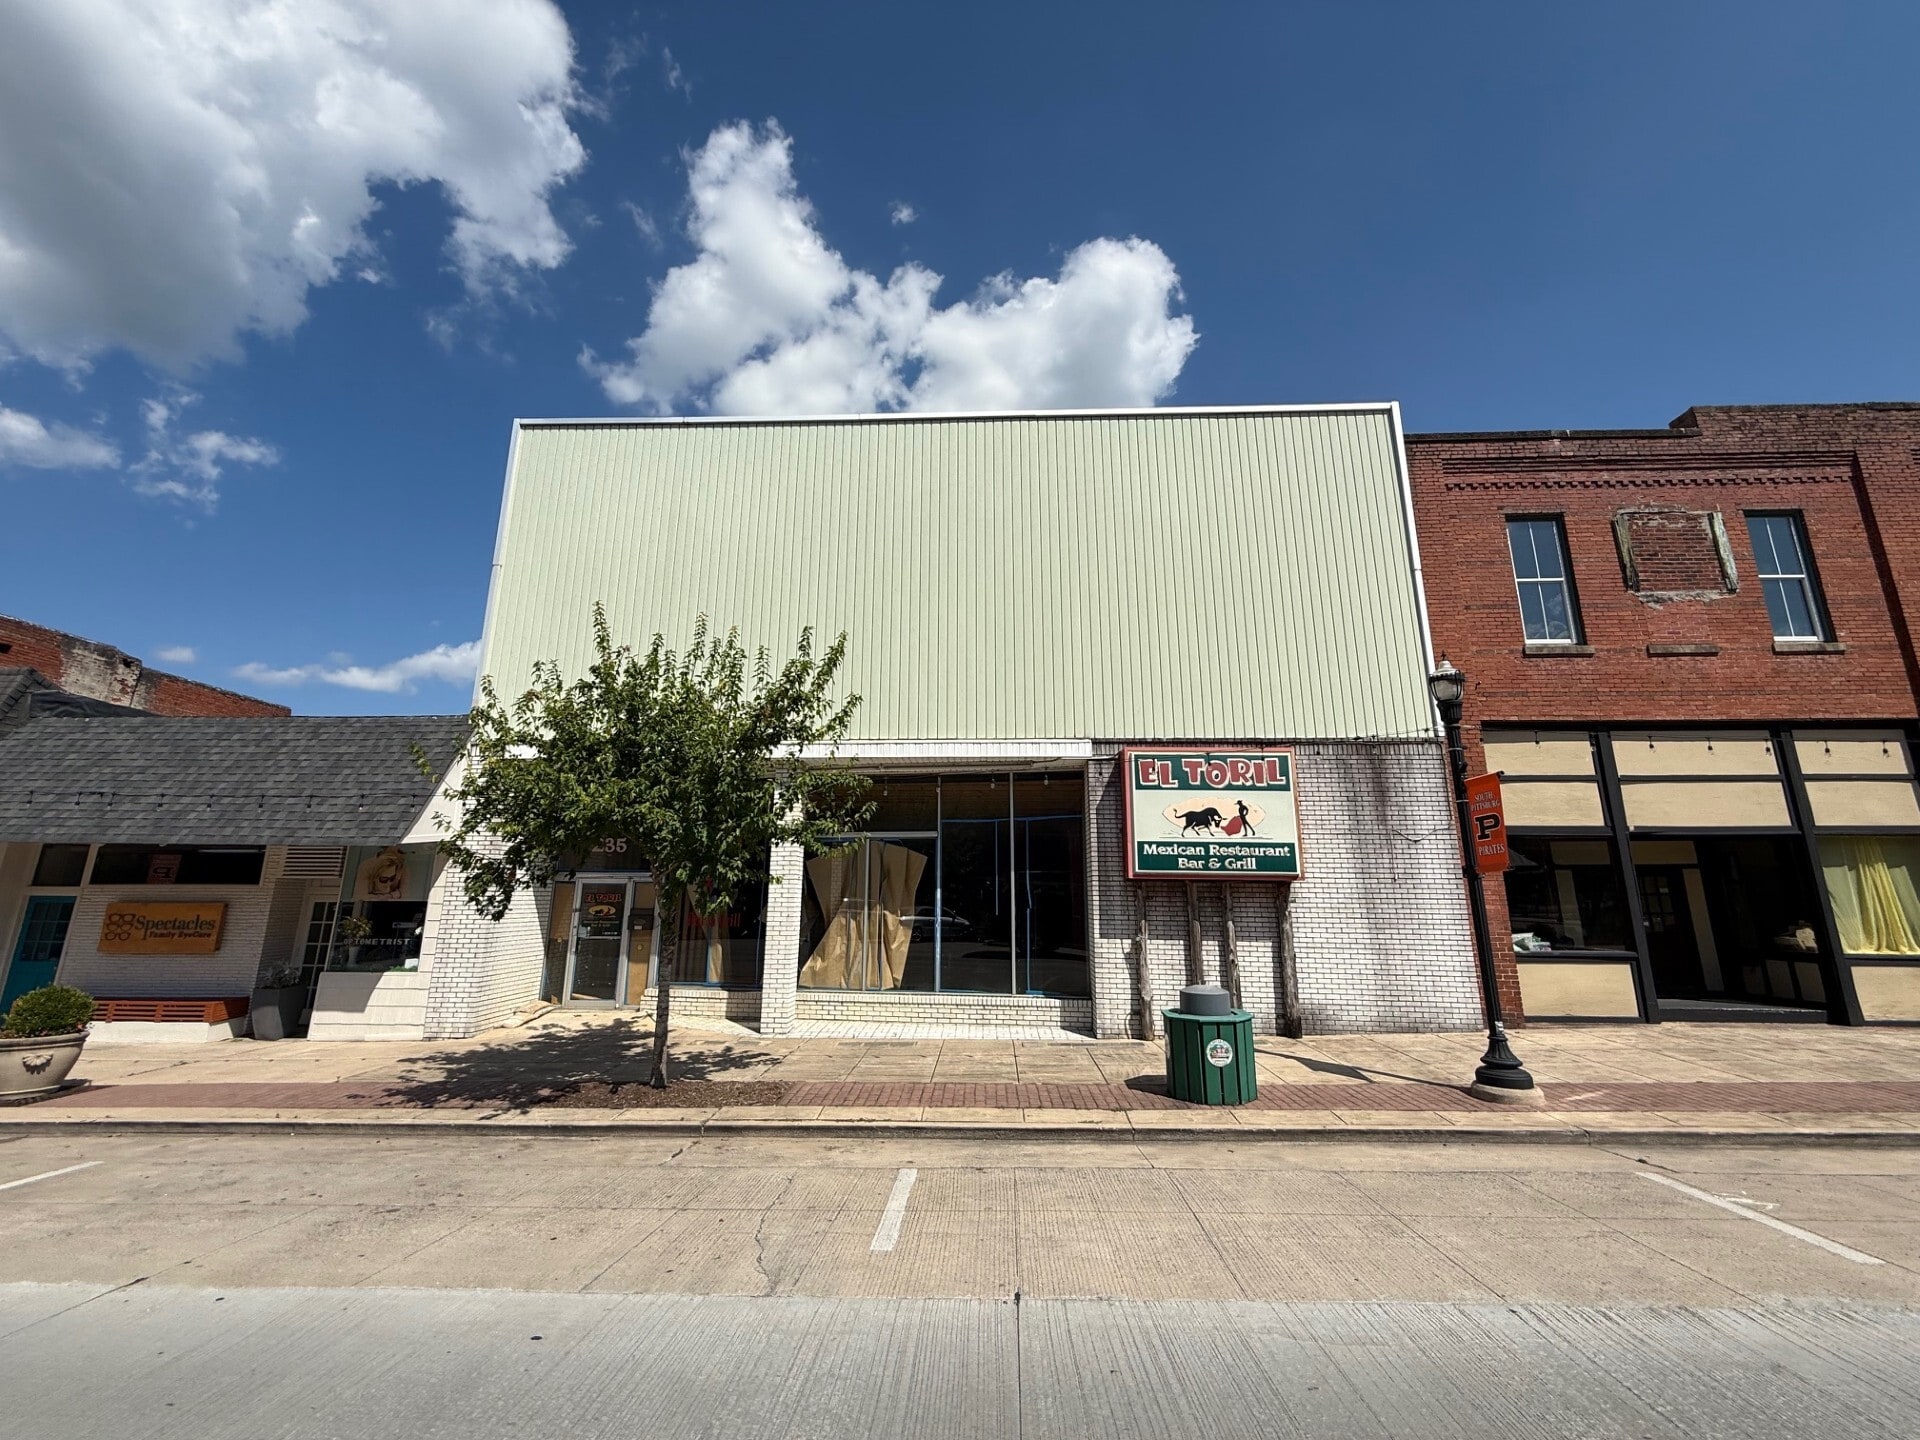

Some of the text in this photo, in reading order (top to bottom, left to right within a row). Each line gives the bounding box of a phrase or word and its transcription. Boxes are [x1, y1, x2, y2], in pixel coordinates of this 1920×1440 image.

[1138, 758, 1286, 788] EL TORIL
[1474, 792, 1494, 801] SOUTH
[1474, 812, 1501, 841] P
[1143, 844, 1290, 857] Mexican Restaurant
[1478, 844, 1505, 856] PIRATES
[1178, 857, 1256, 870] Bar & Grill
[134, 914, 216, 940] Spectacles
[148, 931, 212, 939] Family EyeCare
[344, 938, 410, 946] OPTOMETRIST
